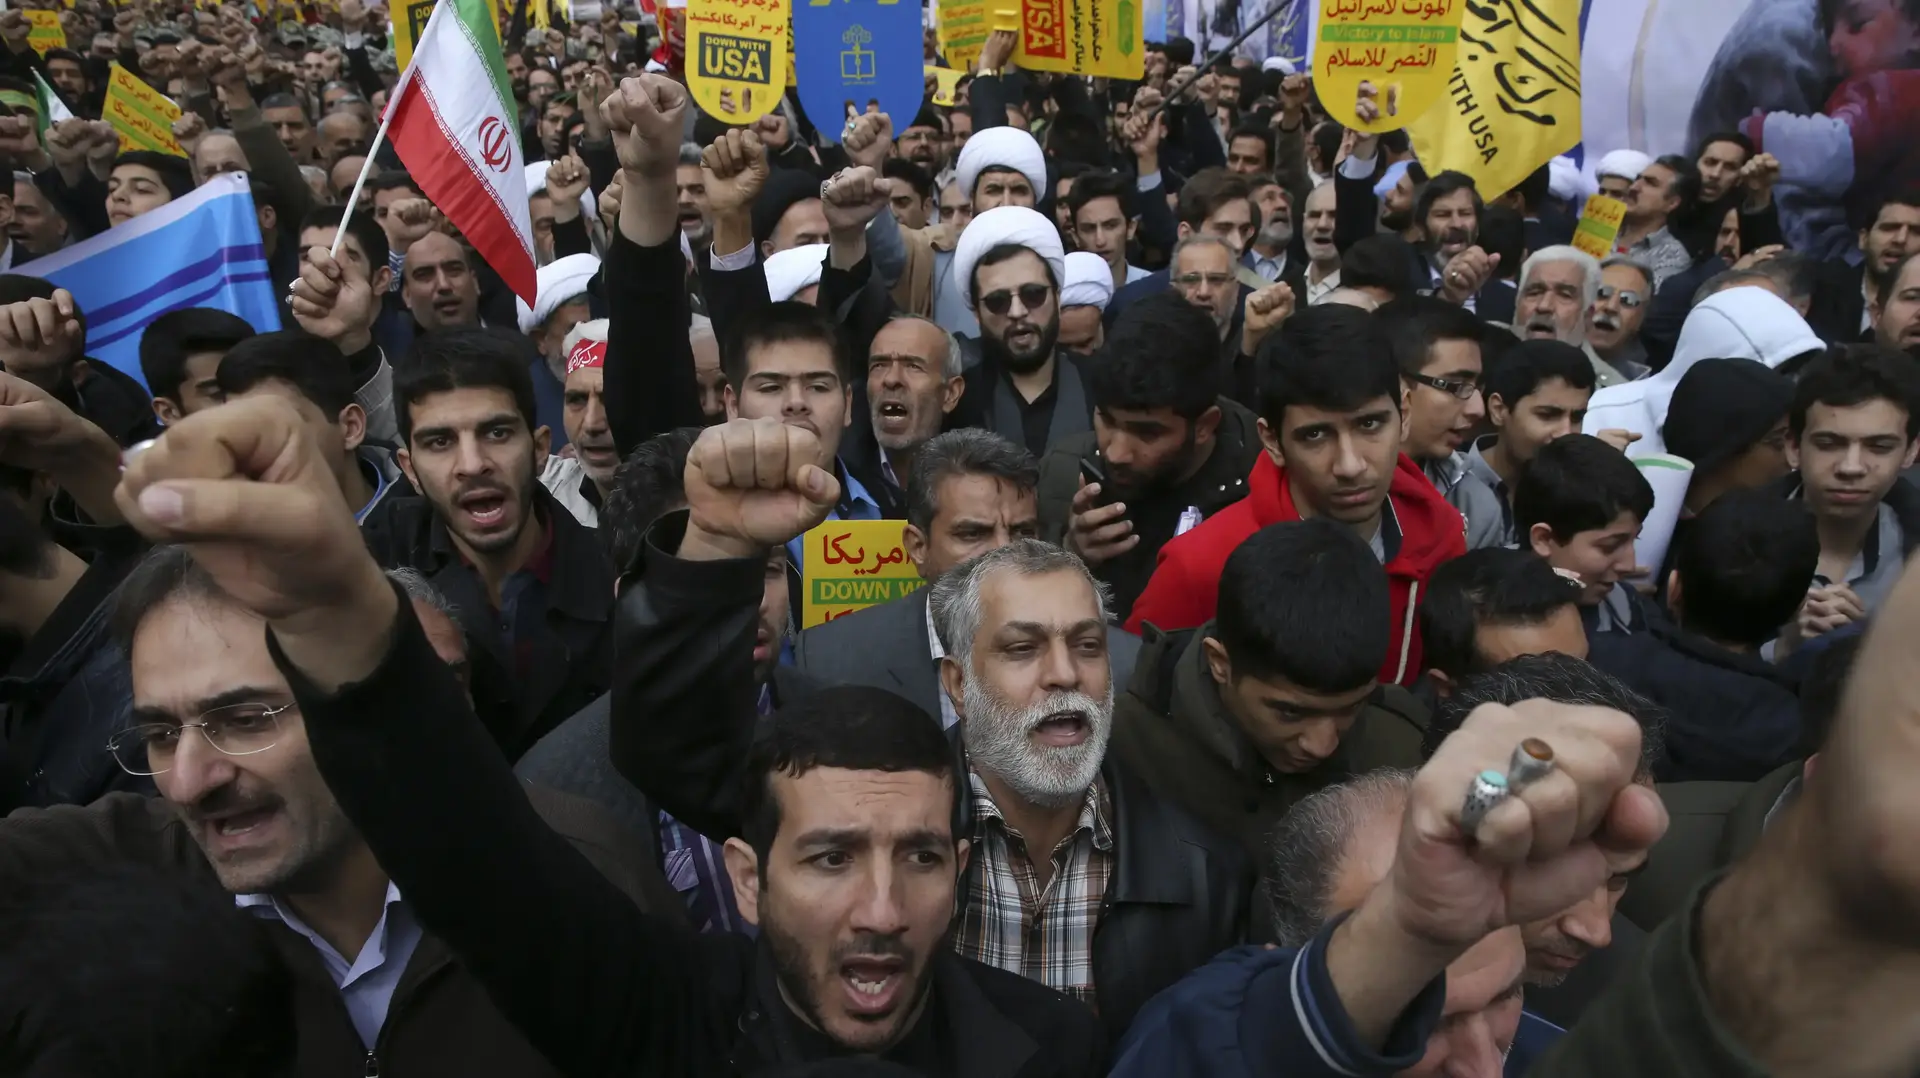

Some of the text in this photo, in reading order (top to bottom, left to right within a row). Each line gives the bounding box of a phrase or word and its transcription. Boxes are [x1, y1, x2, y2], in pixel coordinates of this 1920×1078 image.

[1333, 25, 1446, 41] Victory to Islam
[705, 36, 766, 51] DOWN WITH
[704, 46, 765, 80] USA
[1448, 67, 1499, 166] ITH USA
[820, 581, 891, 600] DOWN
